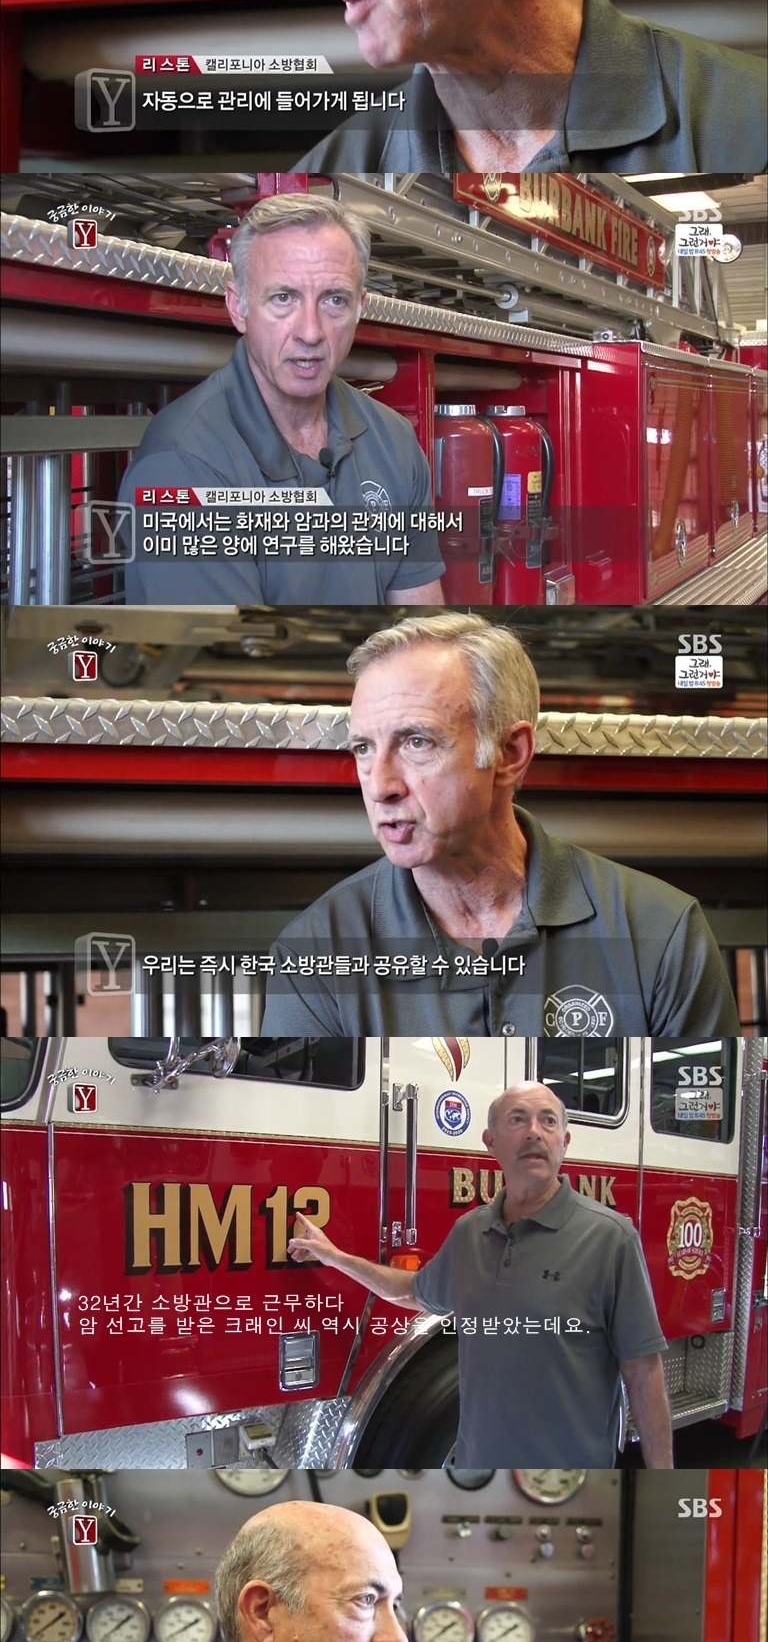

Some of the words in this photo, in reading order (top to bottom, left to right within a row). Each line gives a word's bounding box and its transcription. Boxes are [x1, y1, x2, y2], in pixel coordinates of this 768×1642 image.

[453, 1167, 617, 1206] BUNK
[131, 1182, 253, 1267] HM
[679, 1222, 702, 1248] 100
